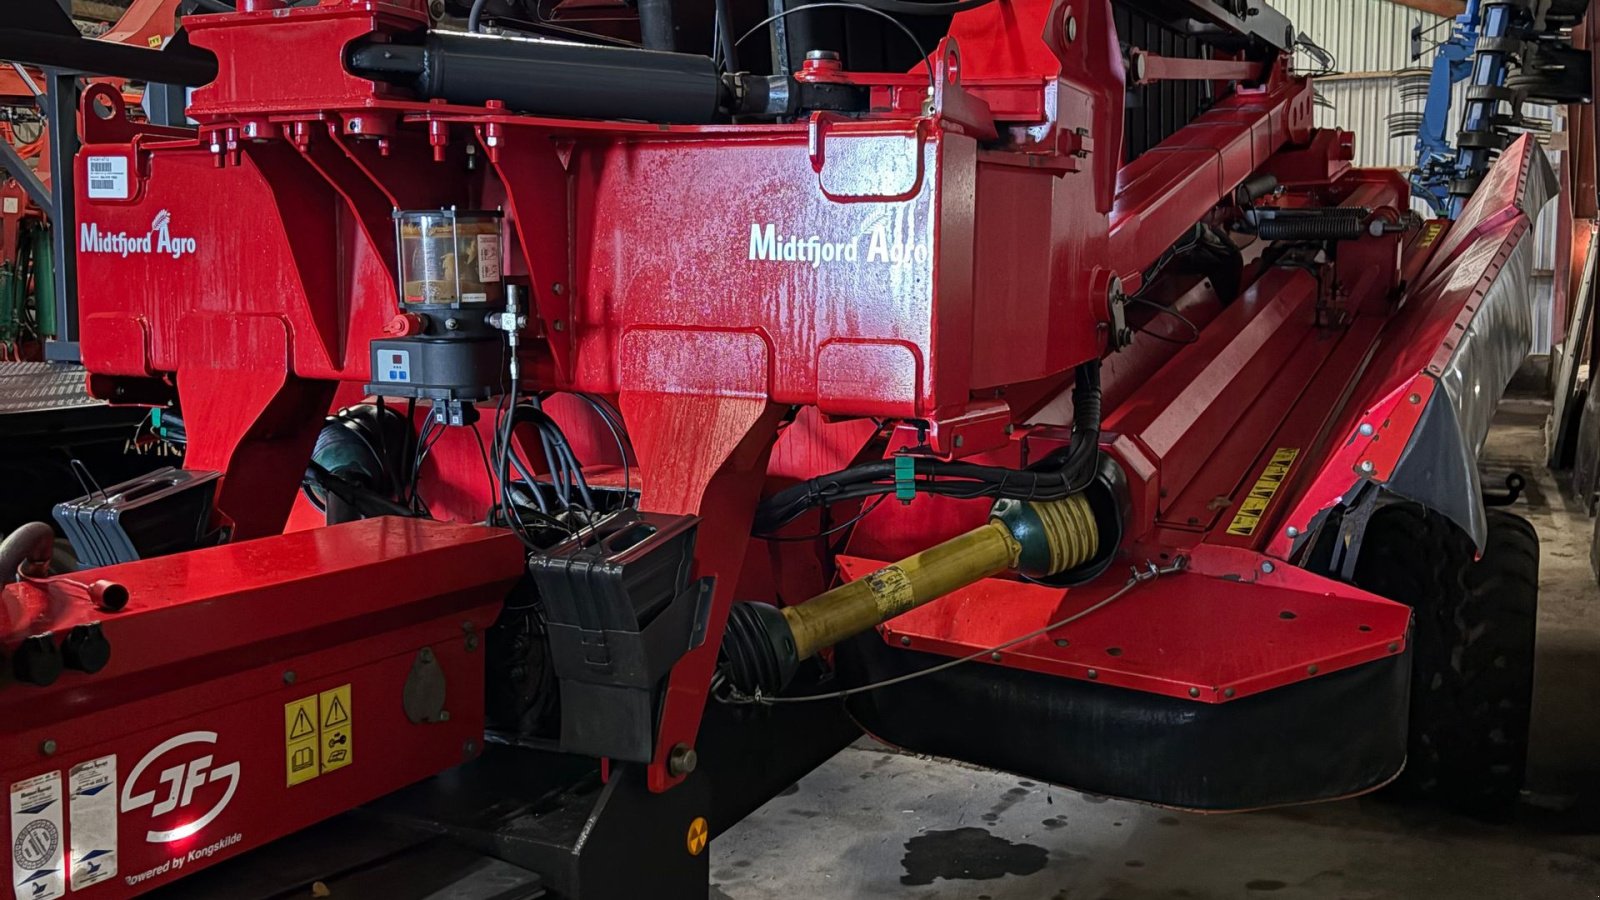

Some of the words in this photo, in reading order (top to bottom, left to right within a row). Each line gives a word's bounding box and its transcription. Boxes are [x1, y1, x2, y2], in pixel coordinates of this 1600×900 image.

[80, 222, 152, 258] Midtfjord
[156, 220, 196, 259] Agro
[748, 223, 858, 269] Midtfjord
[866, 224, 928, 268] Agro
[172, 856, 185, 869] by
[187, 833, 242, 863] Kongskilde
